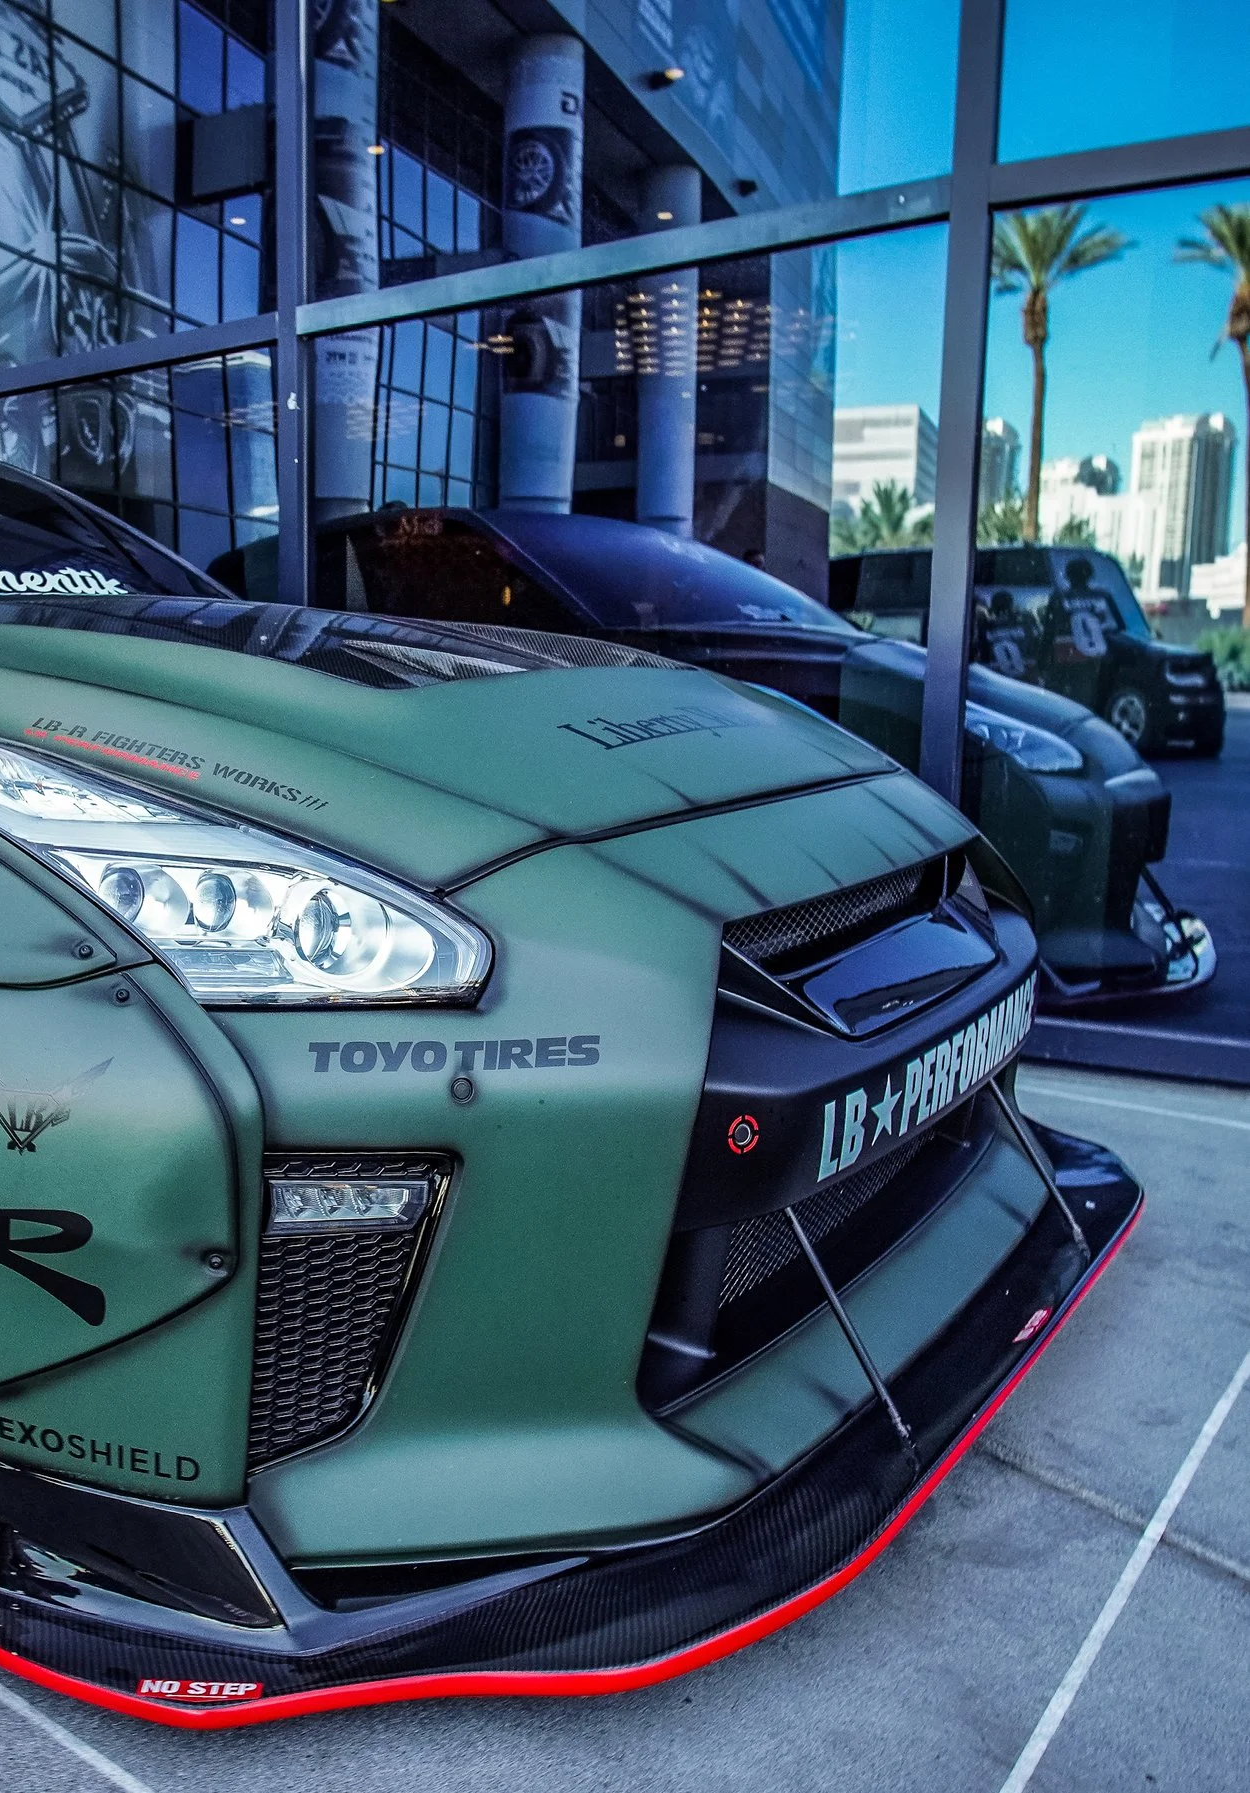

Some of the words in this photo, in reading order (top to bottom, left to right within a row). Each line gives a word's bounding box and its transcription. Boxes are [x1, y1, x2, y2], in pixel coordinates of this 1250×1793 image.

[31, 717, 88, 739] LB-R
[91, 730, 206, 771] FIGHTERS
[308, 1041, 448, 1073] TOYO
[454, 1034, 600, 1071] TIRES
[817, 1087, 868, 1183] LB
[140, 1679, 181, 1694] NO
[186, 1681, 257, 1696] STEP
